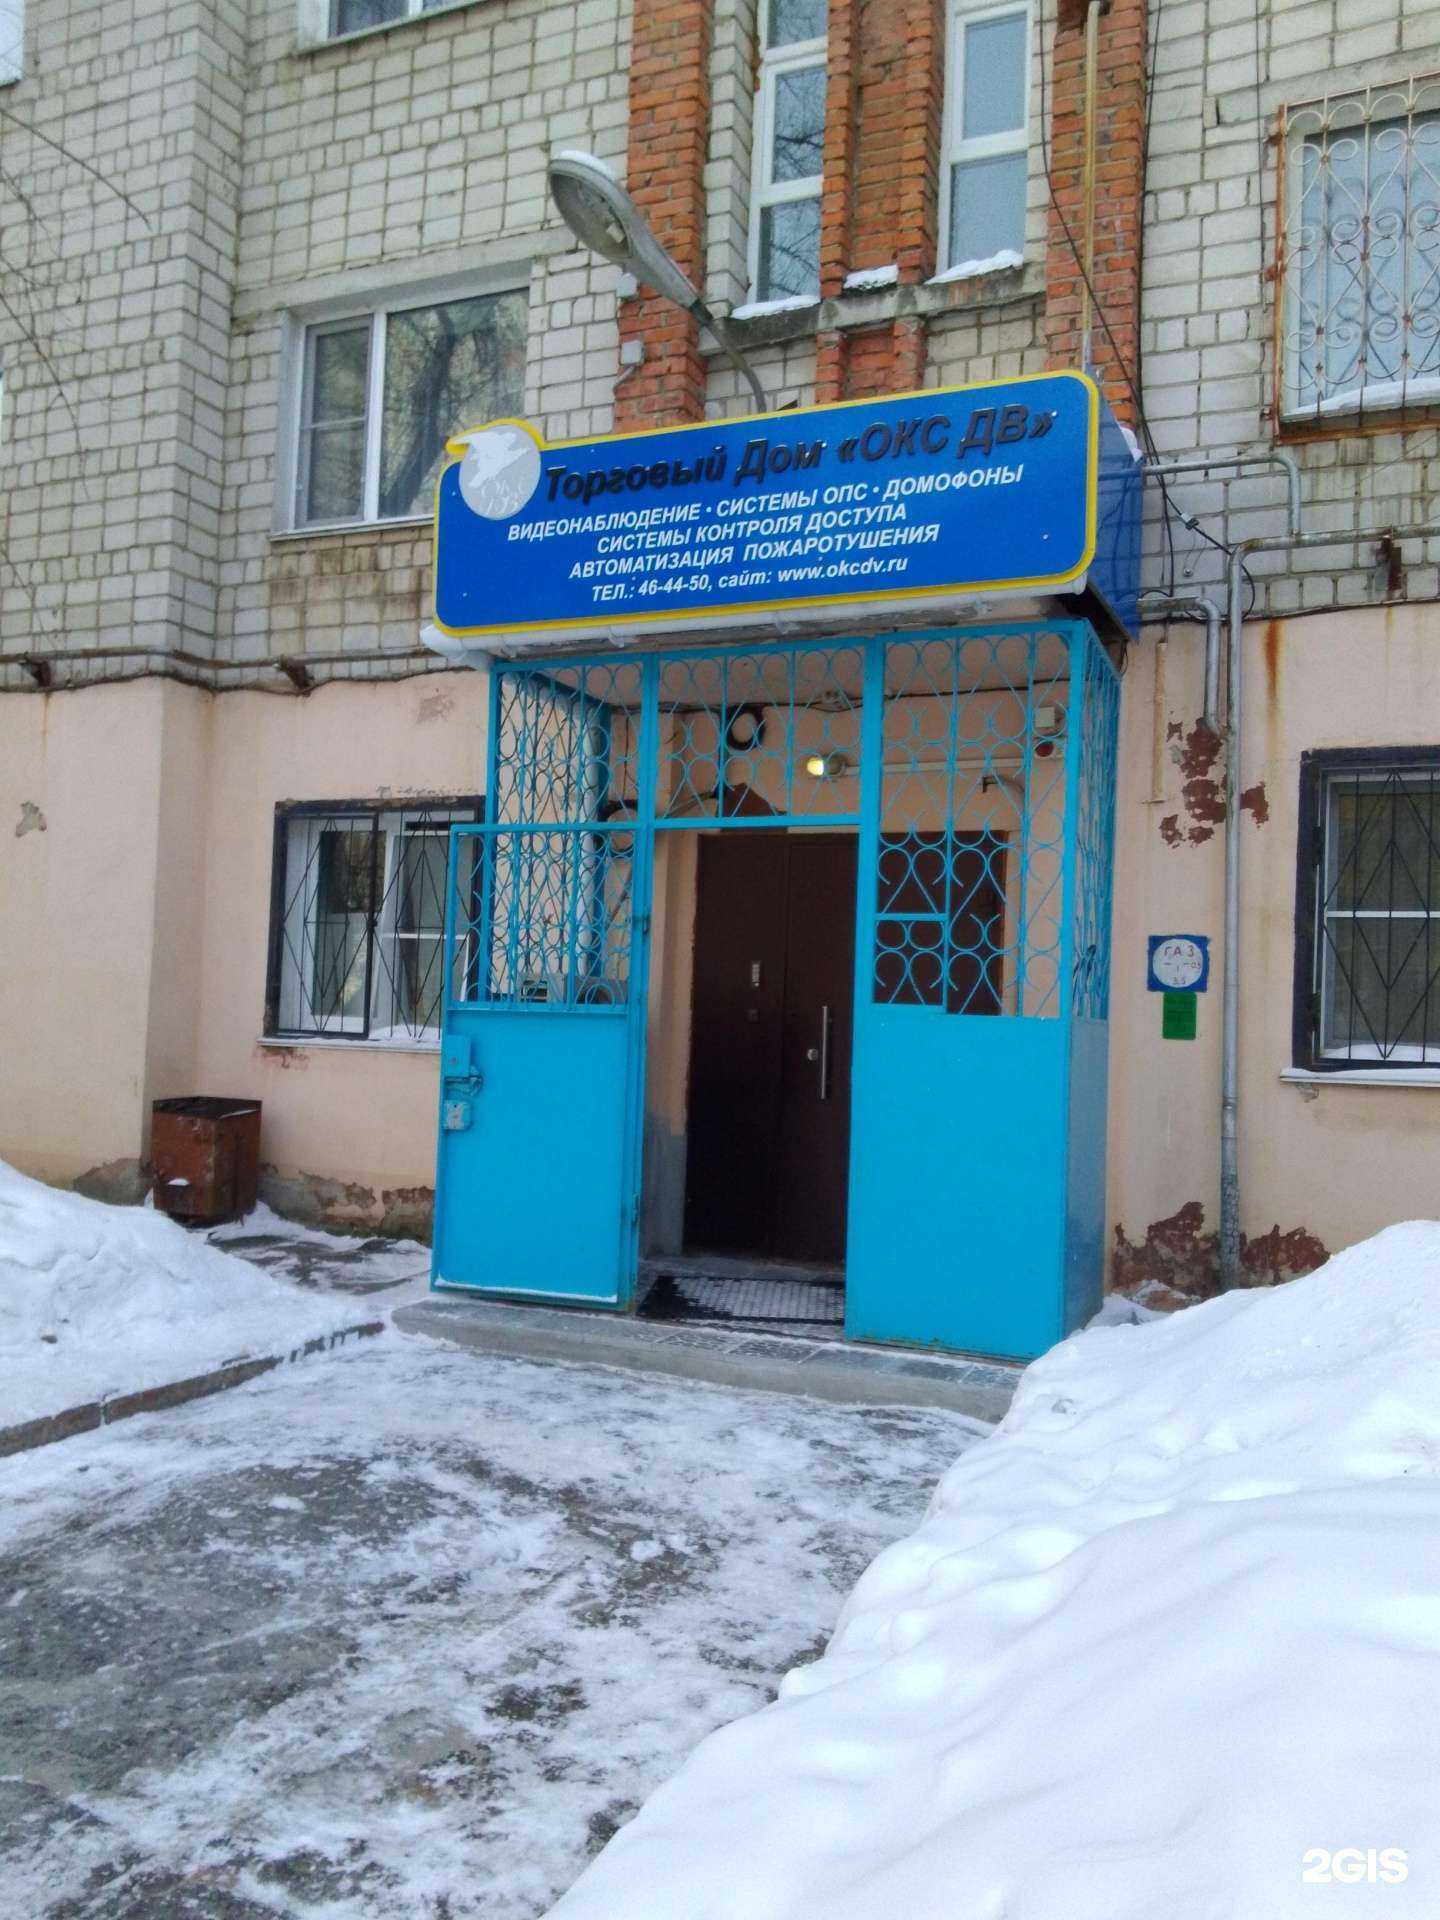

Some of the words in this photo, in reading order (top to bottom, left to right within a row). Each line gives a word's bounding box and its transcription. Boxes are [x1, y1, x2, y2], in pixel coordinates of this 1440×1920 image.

[547, 445, 727, 504] Торговый
[734, 438, 827, 487] Дом
[837, 415, 950, 462] «ОКС
[956, 404, 1056, 459] ДВ»
[508, 503, 701, 542] ВИДЕОНАБЛЮДЕНИЕ
[716, 489, 818, 517] СИСТЕМЫ
[823, 482, 868, 505] ОПС
[882, 464, 1025, 501] ДОМОФОНЫ
[596, 526, 690, 554] СИСТЕМЫ
[695, 515, 802, 544] КОНТРОЛЯ
[805, 503, 907, 535] ДОСТУПА
[568, 546, 734, 579] АВТОМАТИЗАЦИЯ
[743, 523, 941, 562] ПОЖАРОТУШЕНИЯ
[592, 585, 635, 602] ТЕЛ.:
[638, 574, 712, 597] 46-44-50,
[718, 568, 772, 590] сайт:
[777, 555, 908, 582] www.okcdv.ru
